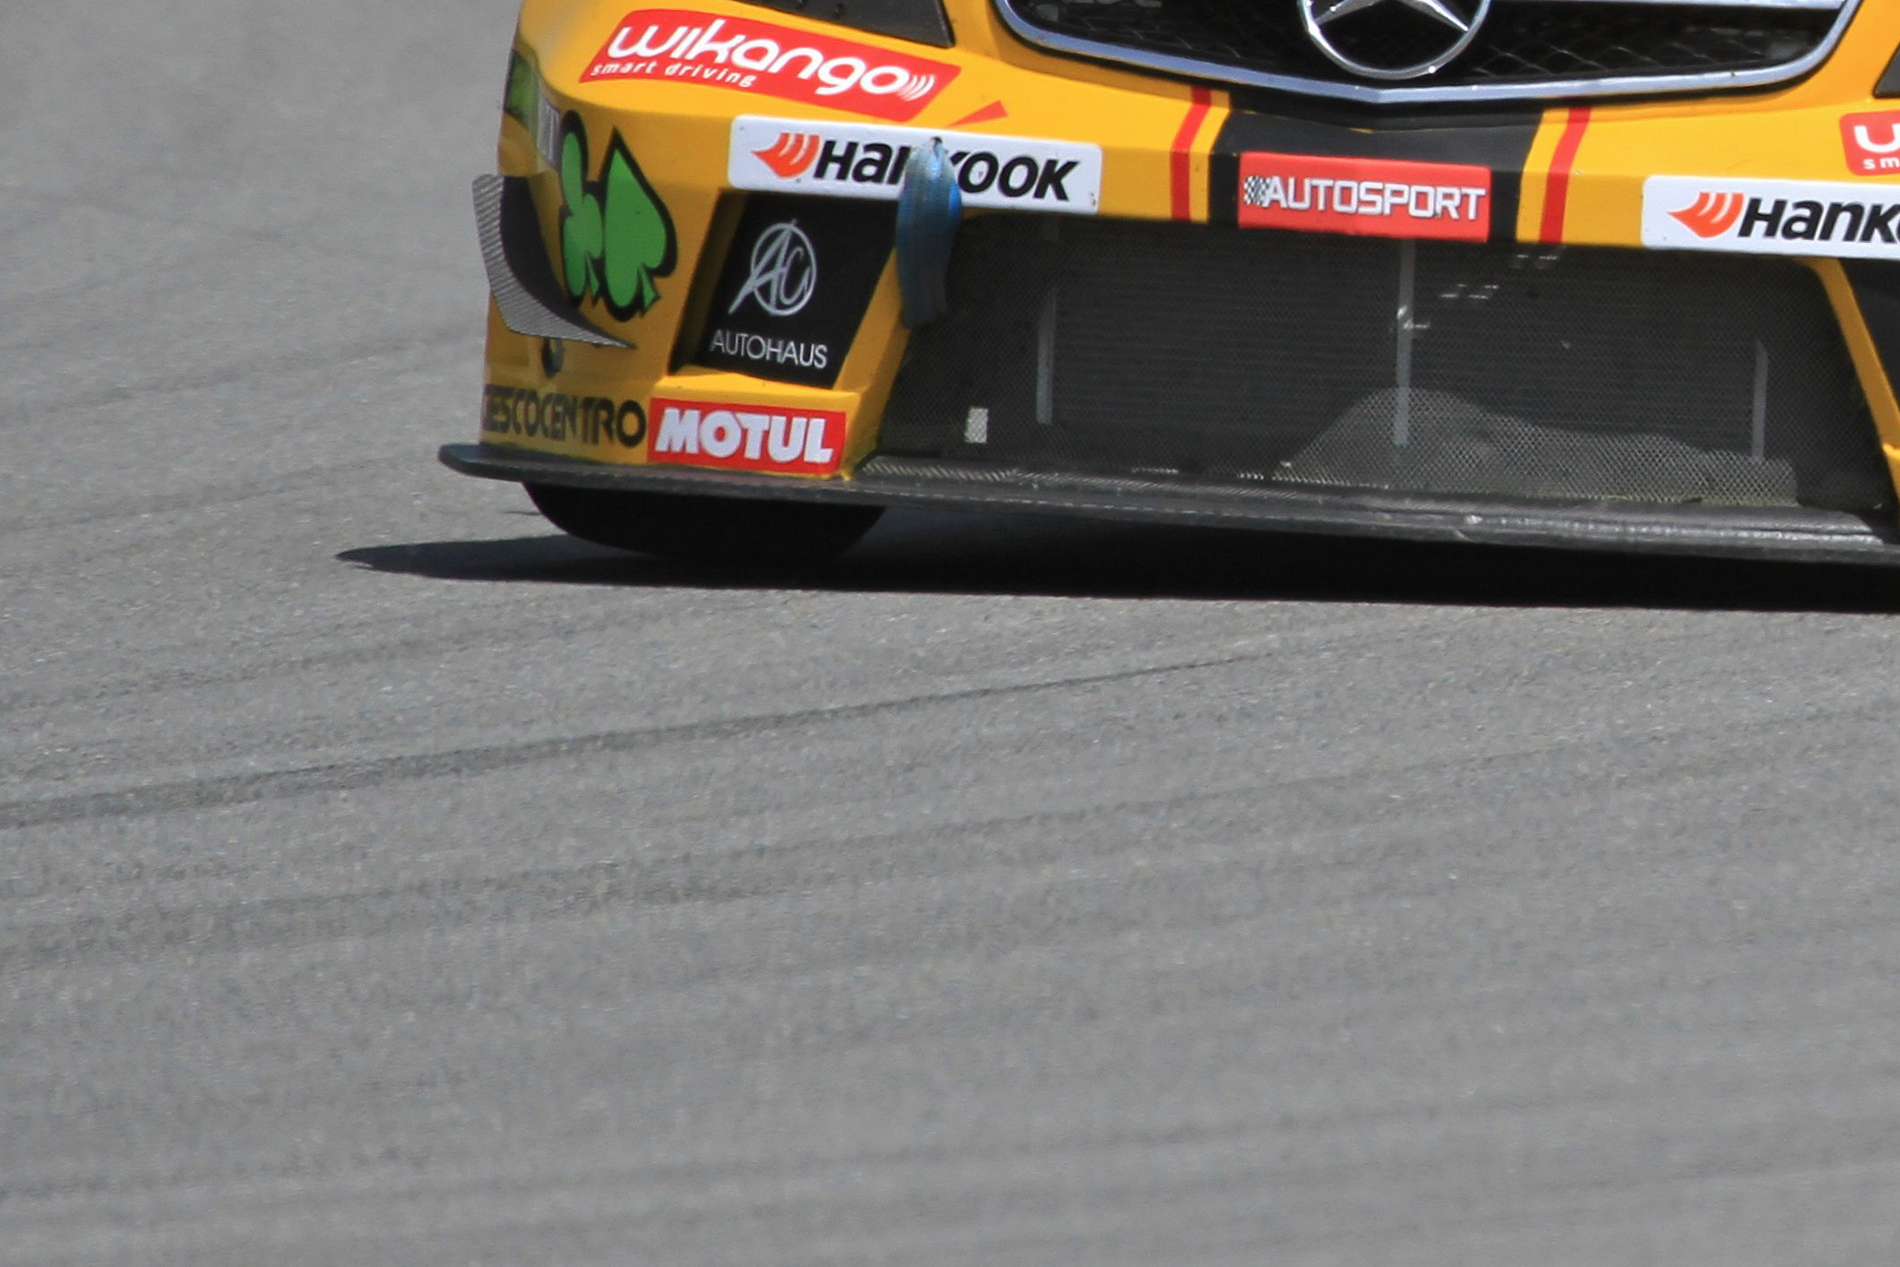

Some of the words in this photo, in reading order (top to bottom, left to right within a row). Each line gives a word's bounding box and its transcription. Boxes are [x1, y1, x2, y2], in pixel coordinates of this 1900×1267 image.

[590, 60, 656, 77] smart
[664, 62, 757, 88] driving
[607, 19, 908, 96] wikango
[1264, 175, 1487, 223] AUTOSPORT
[709, 329, 829, 370] AUTOHAUS
[655, 407, 834, 464] MOTUL
